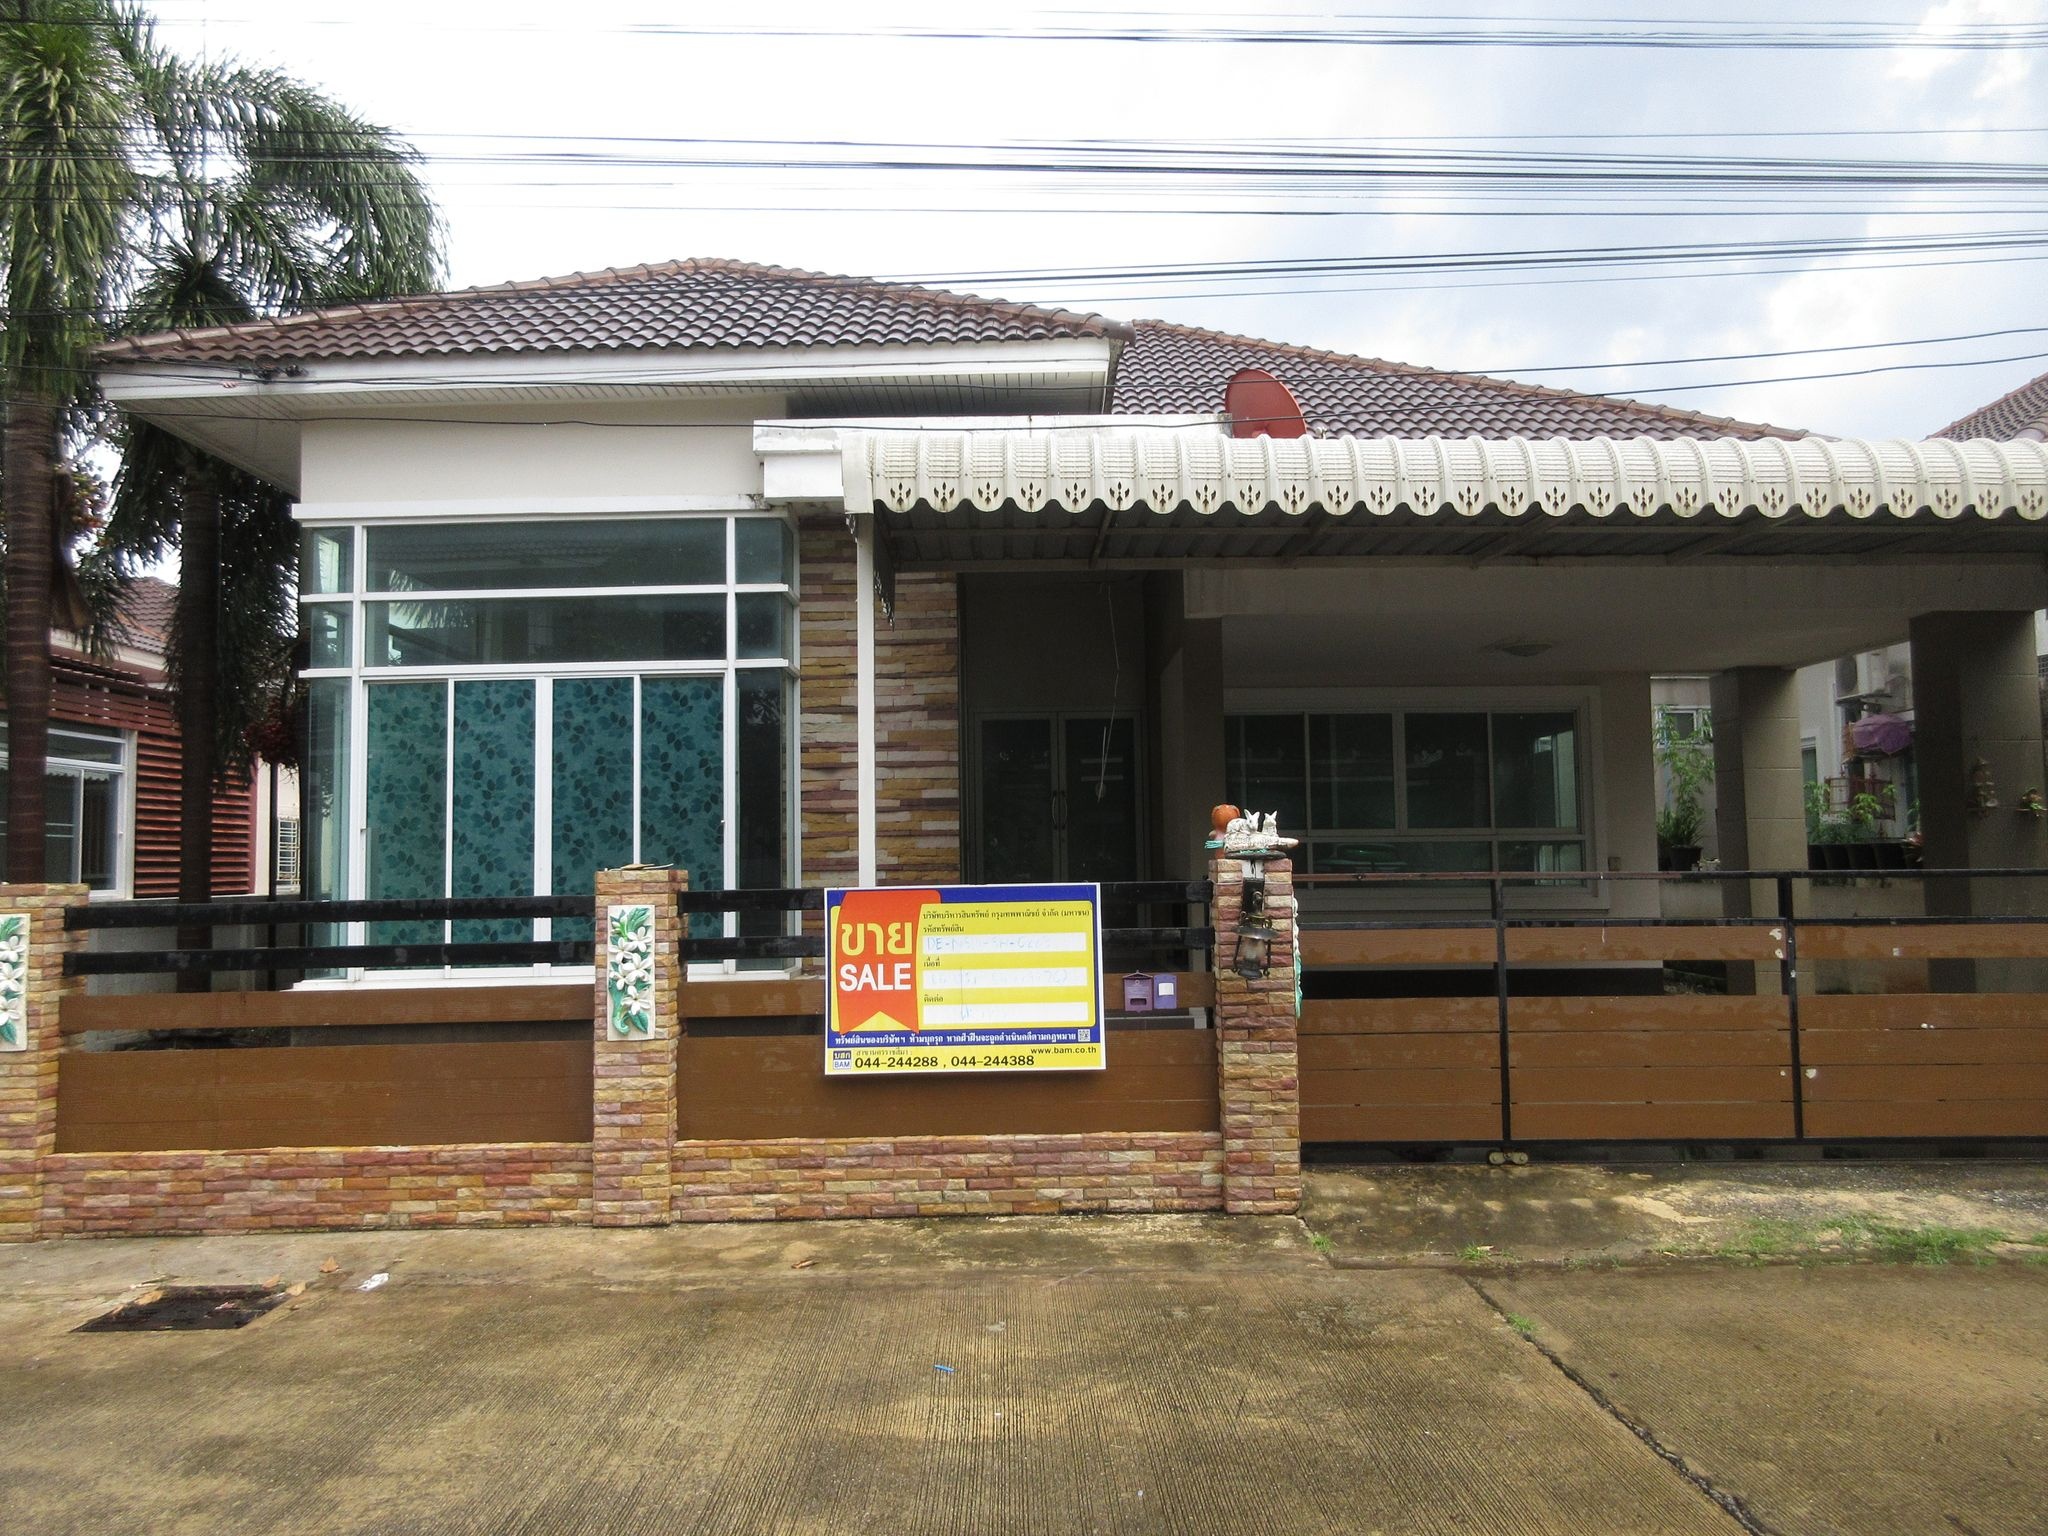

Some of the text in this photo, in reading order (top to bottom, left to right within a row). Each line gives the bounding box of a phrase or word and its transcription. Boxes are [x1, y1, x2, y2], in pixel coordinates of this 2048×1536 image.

[1041, 908, 1059, 917] จำกัด
[1061, 909, 1090, 917] (มหาชน)
[923, 923, 965, 933] รหัสทรัพย์สิน
[841, 922, 913, 956] ขาย
[839, 962, 912, 992] SALE
[909, 1033, 944, 1046] ห้ามบุกรุก
[1030, 1046, 1097, 1054] www.bam.co.th
[834, 1060, 850, 1068] BAM
[854, 1056, 938, 1069] 044-244288
[950, 1055, 1035, 1067] 044-244388
